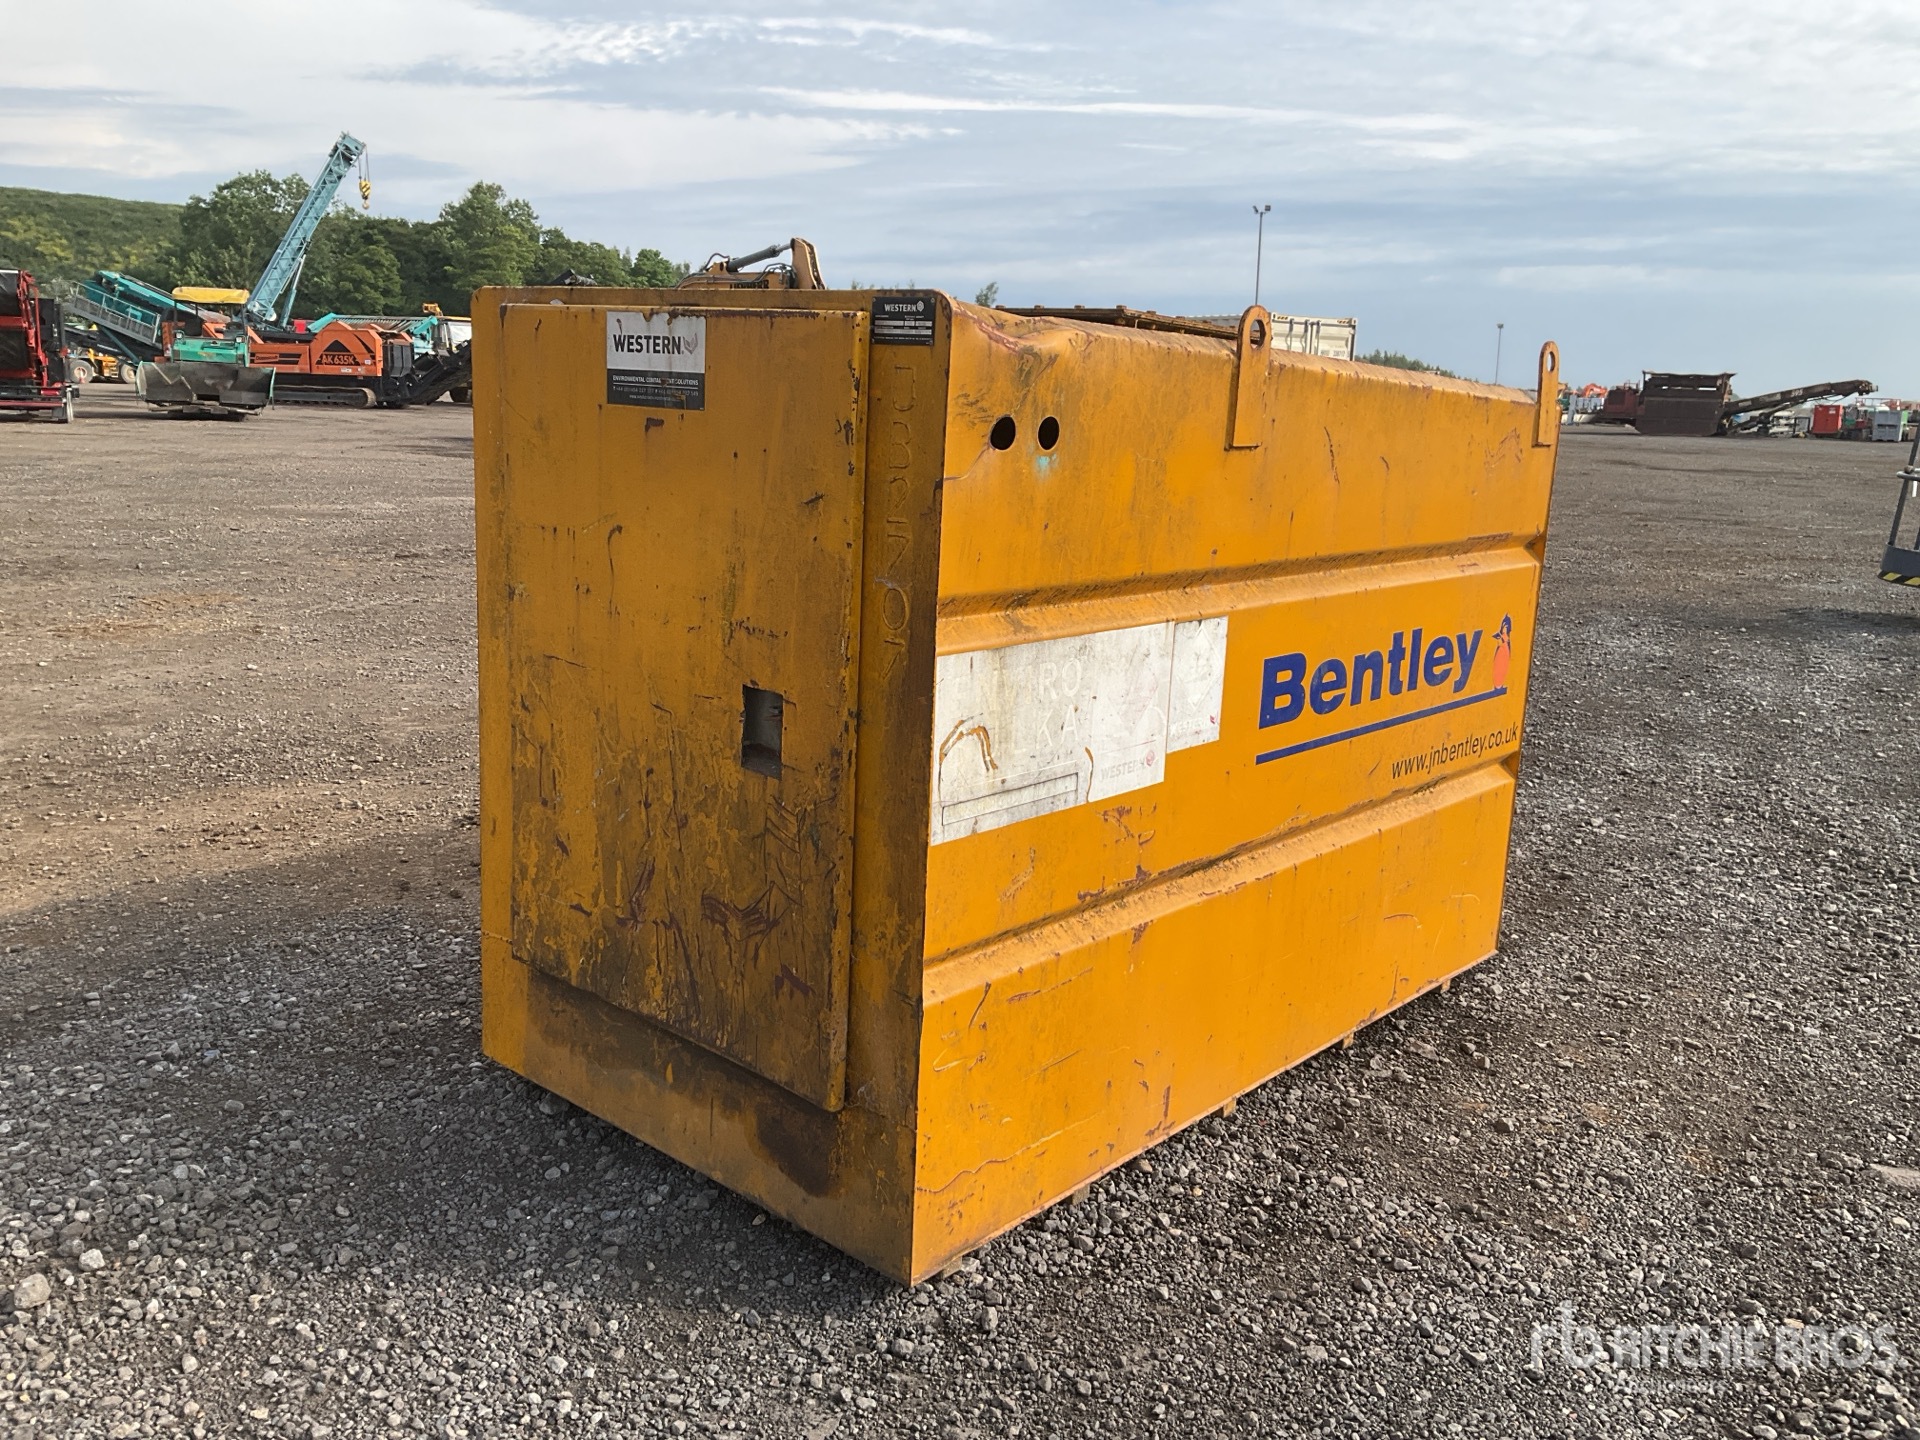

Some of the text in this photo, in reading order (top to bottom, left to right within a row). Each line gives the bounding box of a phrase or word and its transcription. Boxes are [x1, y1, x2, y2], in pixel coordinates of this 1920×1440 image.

[884, 303, 917, 312] WESTERN
[613, 334, 682, 355] WESTERN
[321, 354, 355, 365] AK 635K
[612, 374, 645, 382] ENVIRONMENTAL
[675, 378, 699, 386] SOLUTIONS
[1258, 627, 1484, 730] Bentley
[1391, 721, 1519, 780] www.jnbentley.co.uk
